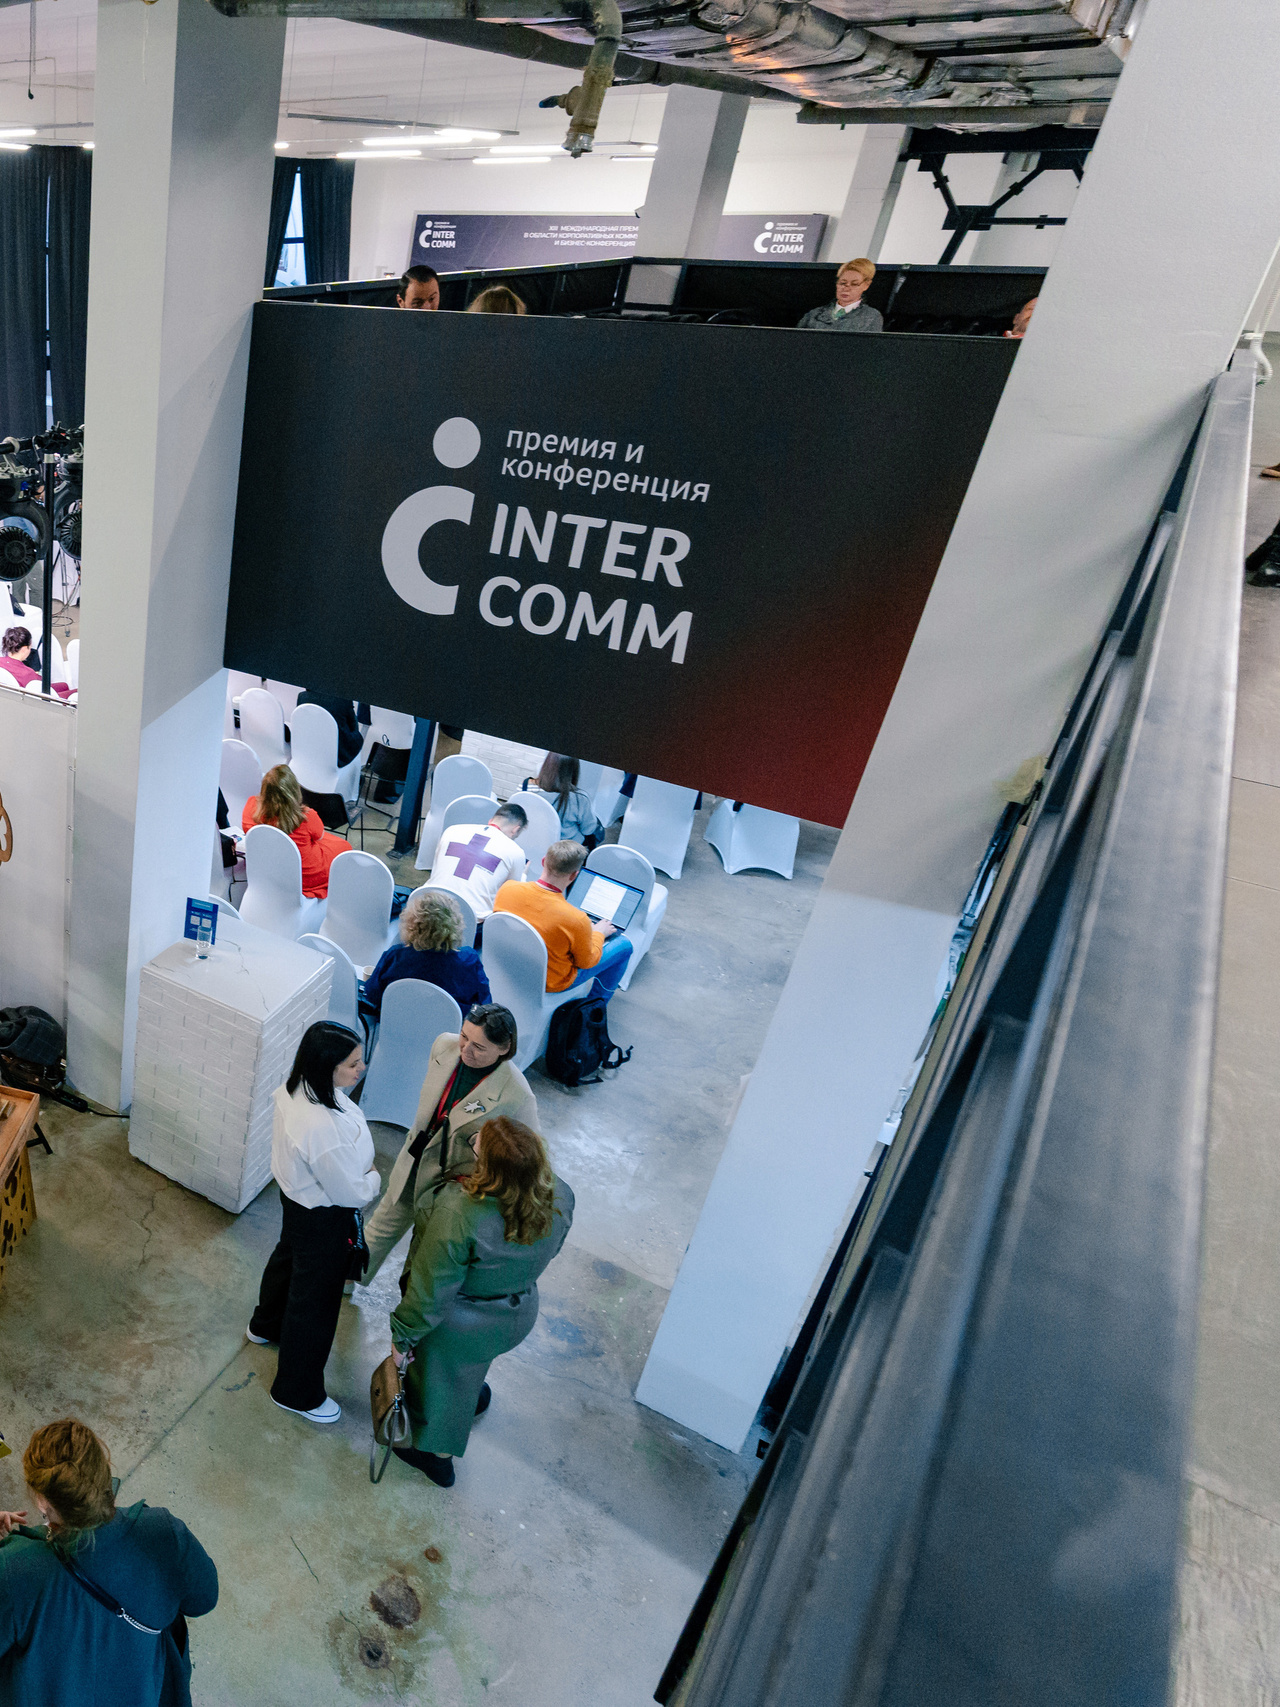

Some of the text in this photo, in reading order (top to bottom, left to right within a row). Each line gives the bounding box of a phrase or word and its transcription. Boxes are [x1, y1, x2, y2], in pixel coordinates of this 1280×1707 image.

[431, 230, 455, 239] INTER
[431, 240, 456, 249] COMM
[772, 233, 804, 243] INTER
[770, 244, 804, 254] COMM
[506, 429, 645, 464] премия и
[501, 457, 711, 503] конференция
[489, 503, 692, 588] INTER
[478, 575, 694, 665] COMM
